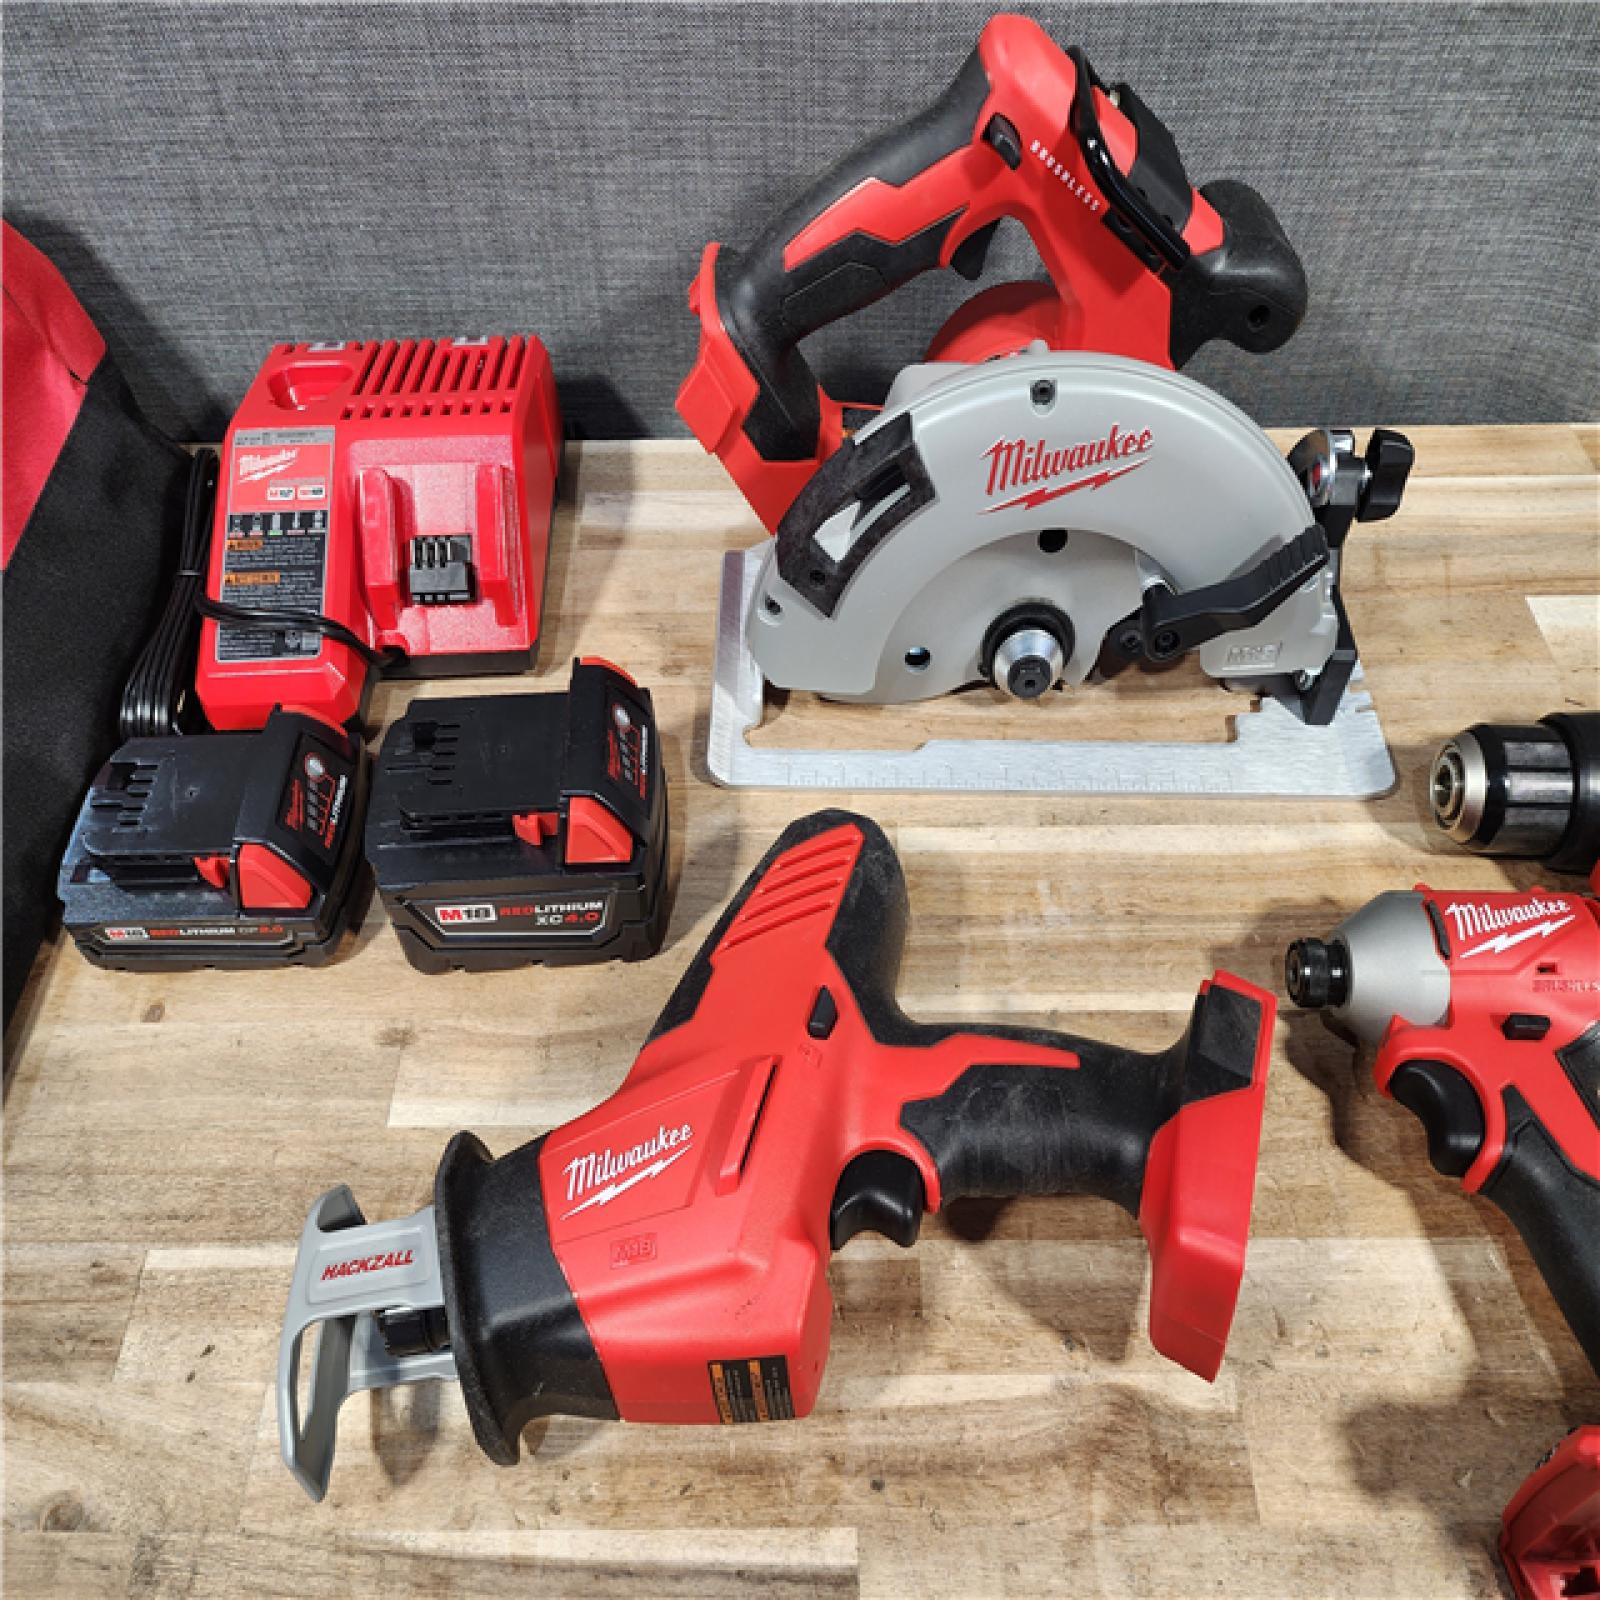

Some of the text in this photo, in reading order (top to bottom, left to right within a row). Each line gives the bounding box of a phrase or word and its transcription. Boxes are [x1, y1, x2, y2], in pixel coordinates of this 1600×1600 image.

[1029, 139, 1100, 211] BRUSHLESS
[980, 423, 1153, 495] Milwaukee
[438, 901, 603, 922] M18 REDLITHIUM
[1445, 897, 1571, 942] Milwaukee
[563, 1124, 693, 1201] Milwaukee
[320, 1249, 413, 1281] HACKZALL
